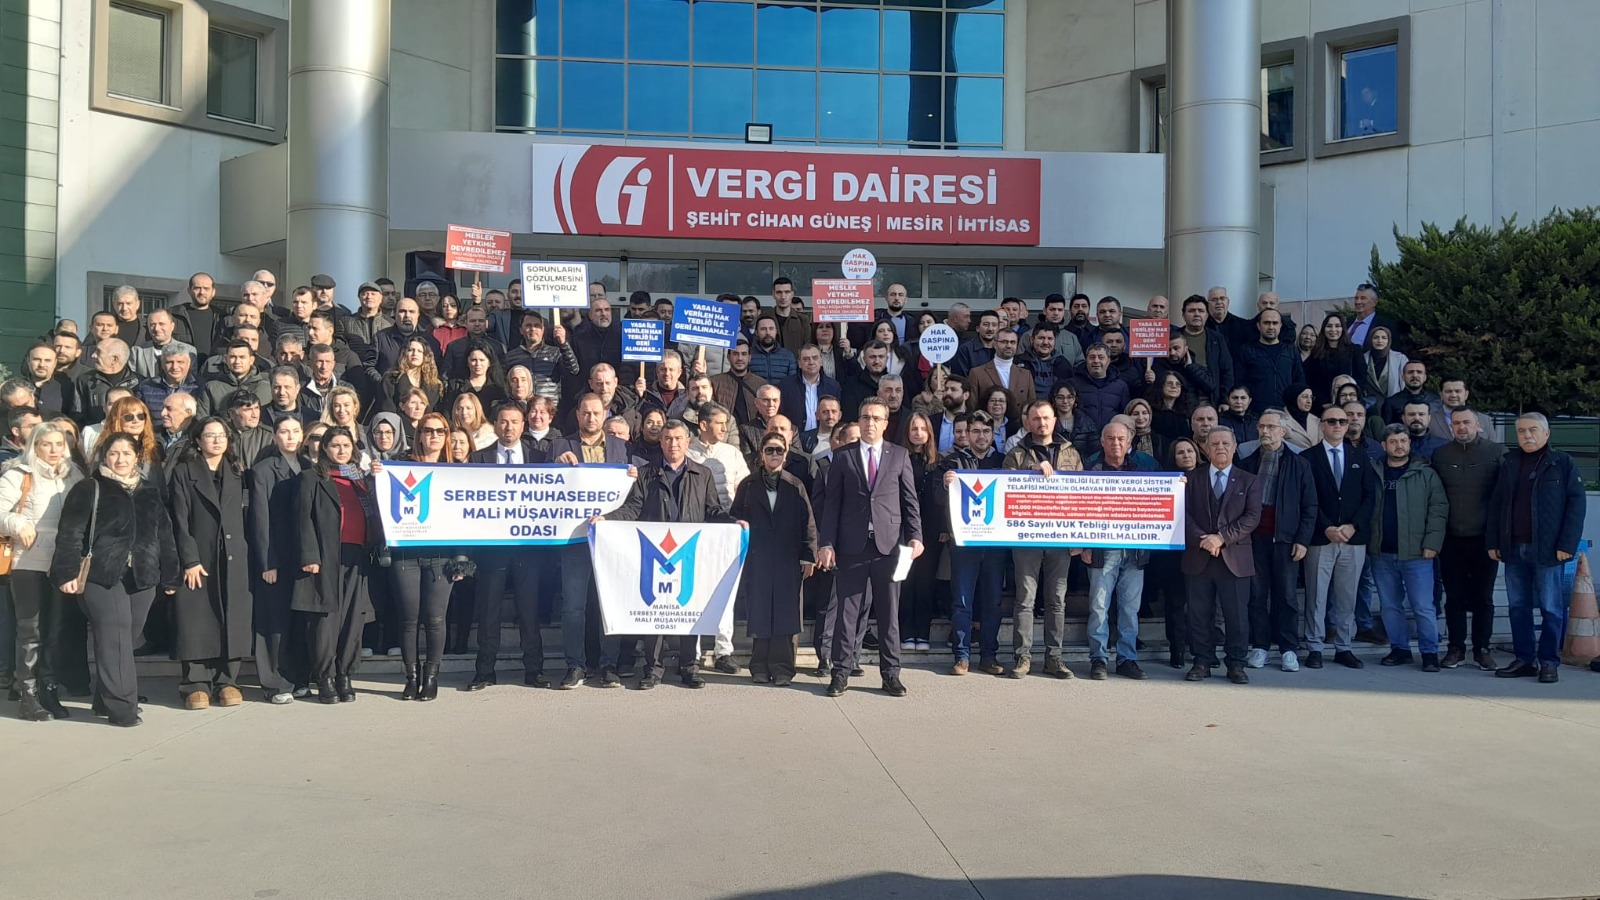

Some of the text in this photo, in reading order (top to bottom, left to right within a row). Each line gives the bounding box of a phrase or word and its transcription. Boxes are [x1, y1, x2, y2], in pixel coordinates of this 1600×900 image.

[686, 164, 997, 205] VERGİ DAİRESİ
[687, 209, 1030, 233] ŞEHİT CİHAN GÜNEŞ MESİR İHTİSAS
[465, 232, 494, 241] MESLEK
[450, 244, 507, 256] DEVREDİLEMEZ
[844, 259, 874, 267] GASPINA
[526, 273, 584, 283] ÇÖZÜLMESİNİ
[533, 283, 577, 291] İSTİYORUZ
[692, 304, 723, 313] YASA İLE
[683, 309, 714, 319] VERİLEN
[674, 322, 692, 331] GERİ
[687, 316, 725, 328] TEBLİĞ İLE
[921, 336, 955, 344] GASPINA
[1101, 477, 1120, 485] TÜRK
[1007, 483, 1038, 491] TELAFİSİ
[443, 490, 517, 502] SERBEST
[404, 506, 414, 515] M
[1007, 520, 1026, 528] 586
[1028, 520, 1054, 529] Sayılı
[1078, 521, 1110, 530] Tebliği
[1112, 522, 1172, 531] uygulamaya
[510, 525, 557, 537] ODASI
[1018, 532, 1161, 541] geçmeden KALDIRILMALIDIR.
[658, 582, 673, 593] M
